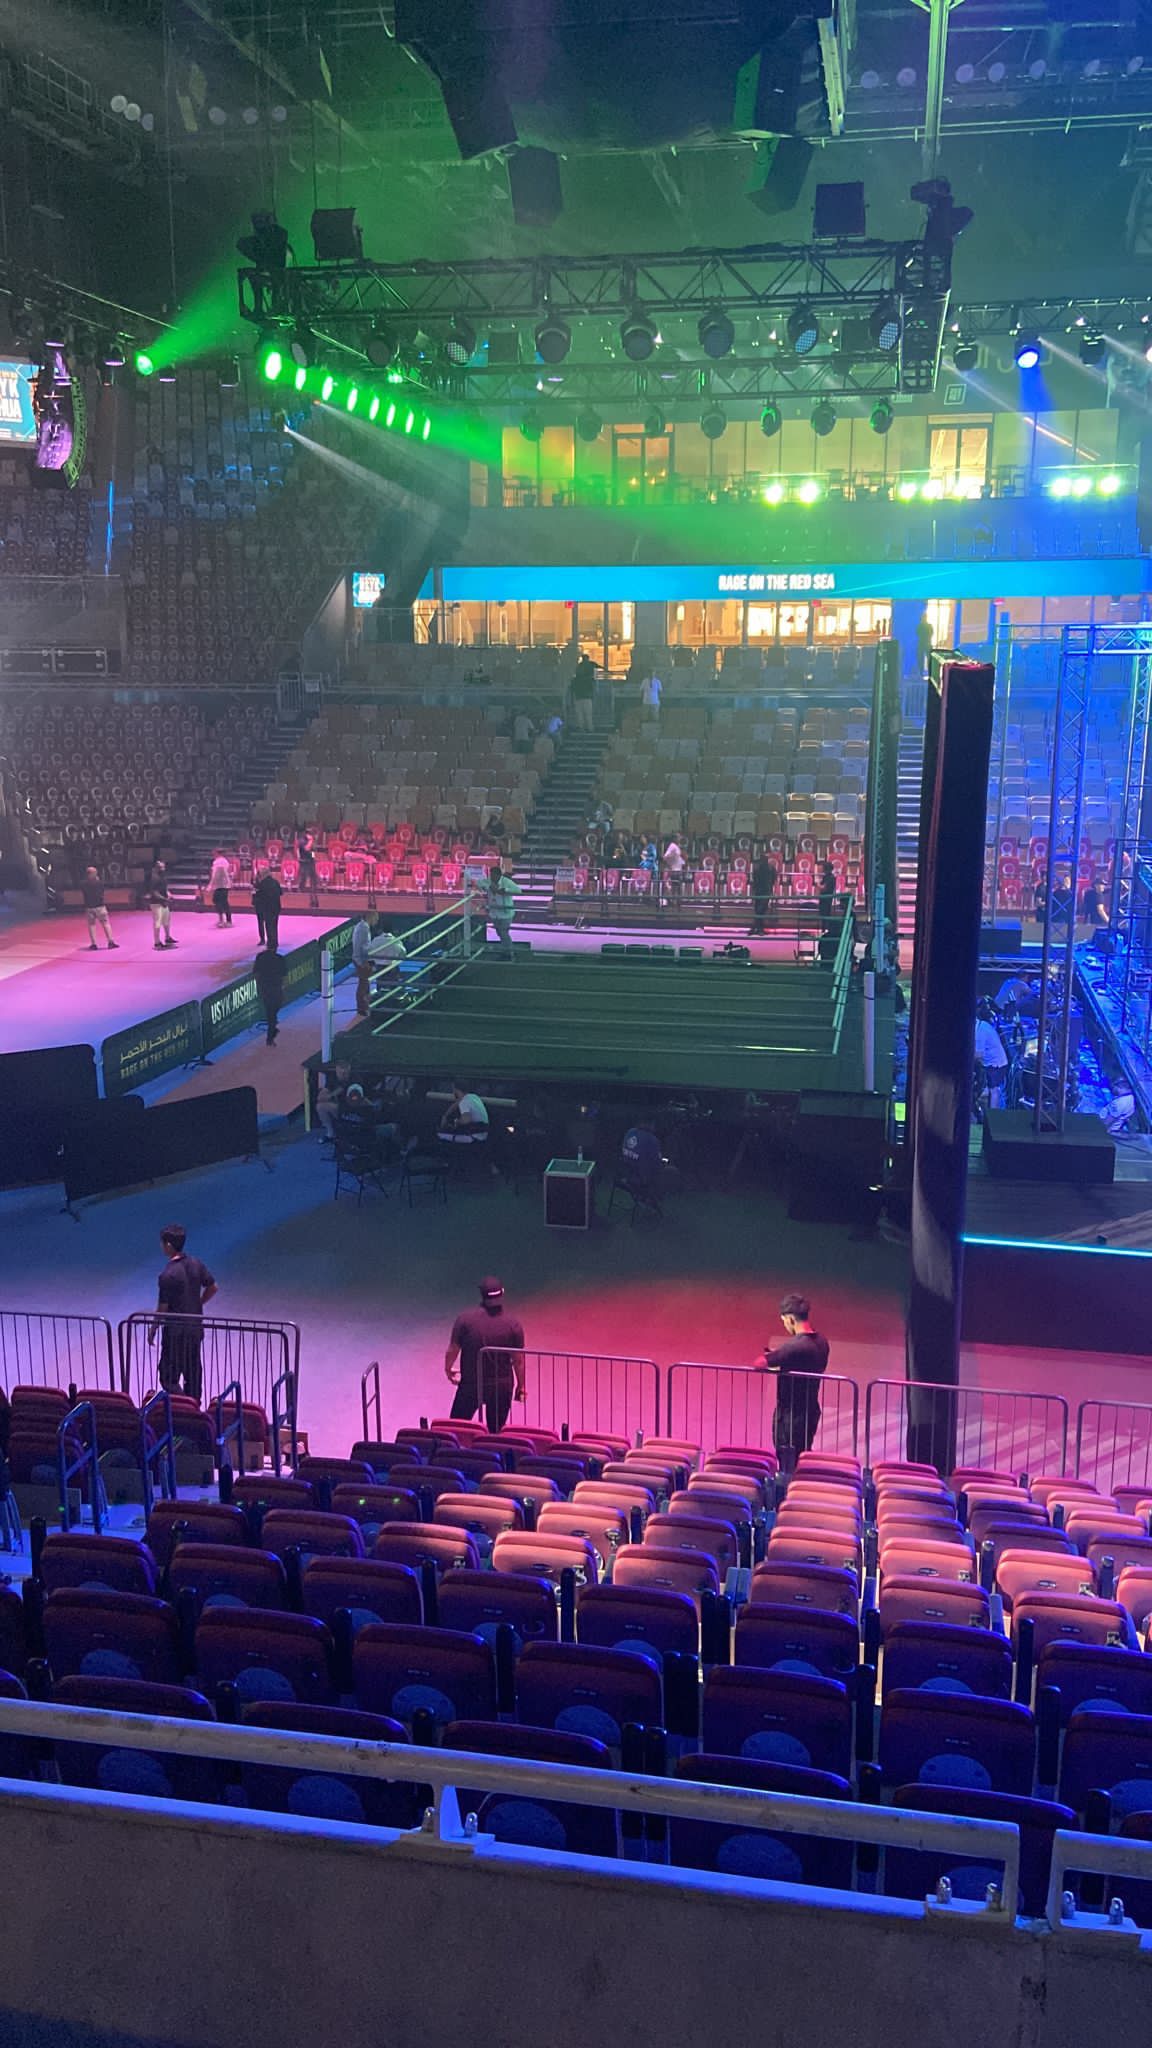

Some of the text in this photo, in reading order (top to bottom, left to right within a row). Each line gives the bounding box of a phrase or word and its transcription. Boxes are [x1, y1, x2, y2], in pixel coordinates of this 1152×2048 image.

[0, 378, 20, 398] YK
[718, 573, 835, 590] RAGE ON THE RED SEA
[211, 978, 258, 1025] USYK JOSHUA
